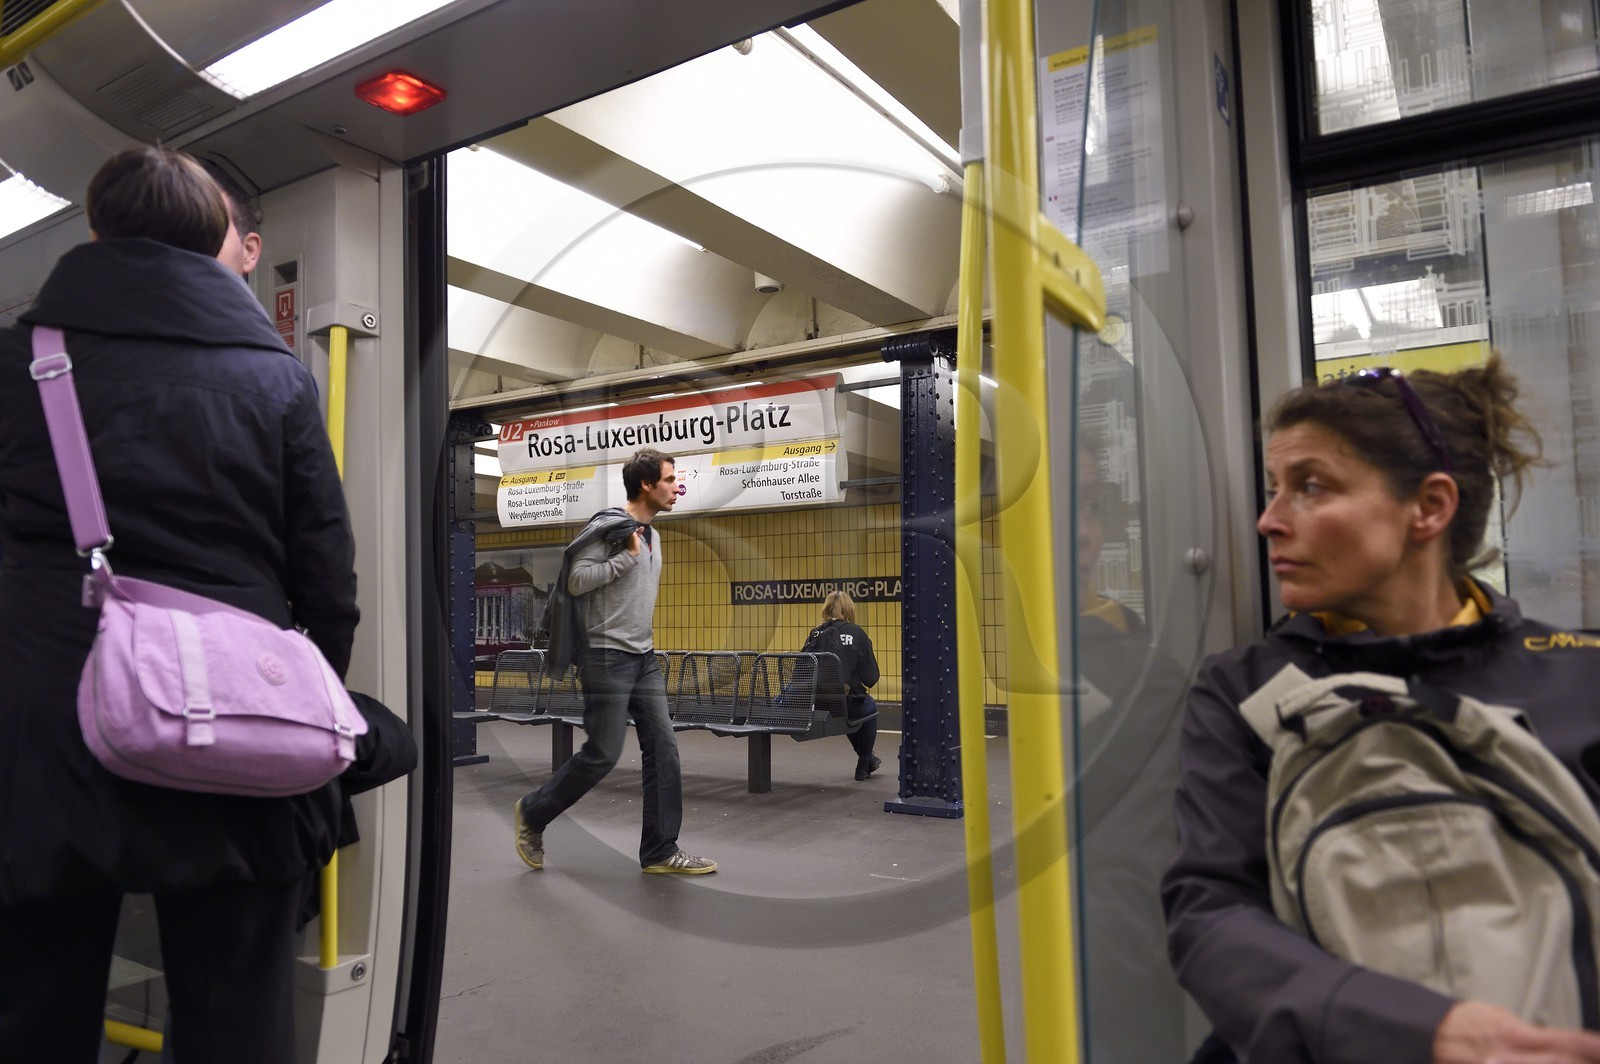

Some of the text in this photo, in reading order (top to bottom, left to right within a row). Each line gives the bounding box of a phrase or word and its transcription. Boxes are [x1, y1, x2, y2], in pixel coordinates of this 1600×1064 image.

[533, 417, 560, 429] Pankow
[500, 422, 523, 442] U2
[527, 402, 792, 459] Rosa-Luxemburg-Platz
[783, 443, 822, 457] Ausgang
[719, 457, 820, 477] Rosa-Luxemburg-Straße
[509, 474, 538, 486] Ausgang
[741, 472, 820, 489] Schönhauser Allee
[507, 480, 585, 497] Rosa-Luxemburg-Straße
[780, 487, 823, 501] Torstraße
[507, 495, 579, 509] Rosa-Luxemburg-Platz
[508, 508, 563, 522] Weydingerstraße
